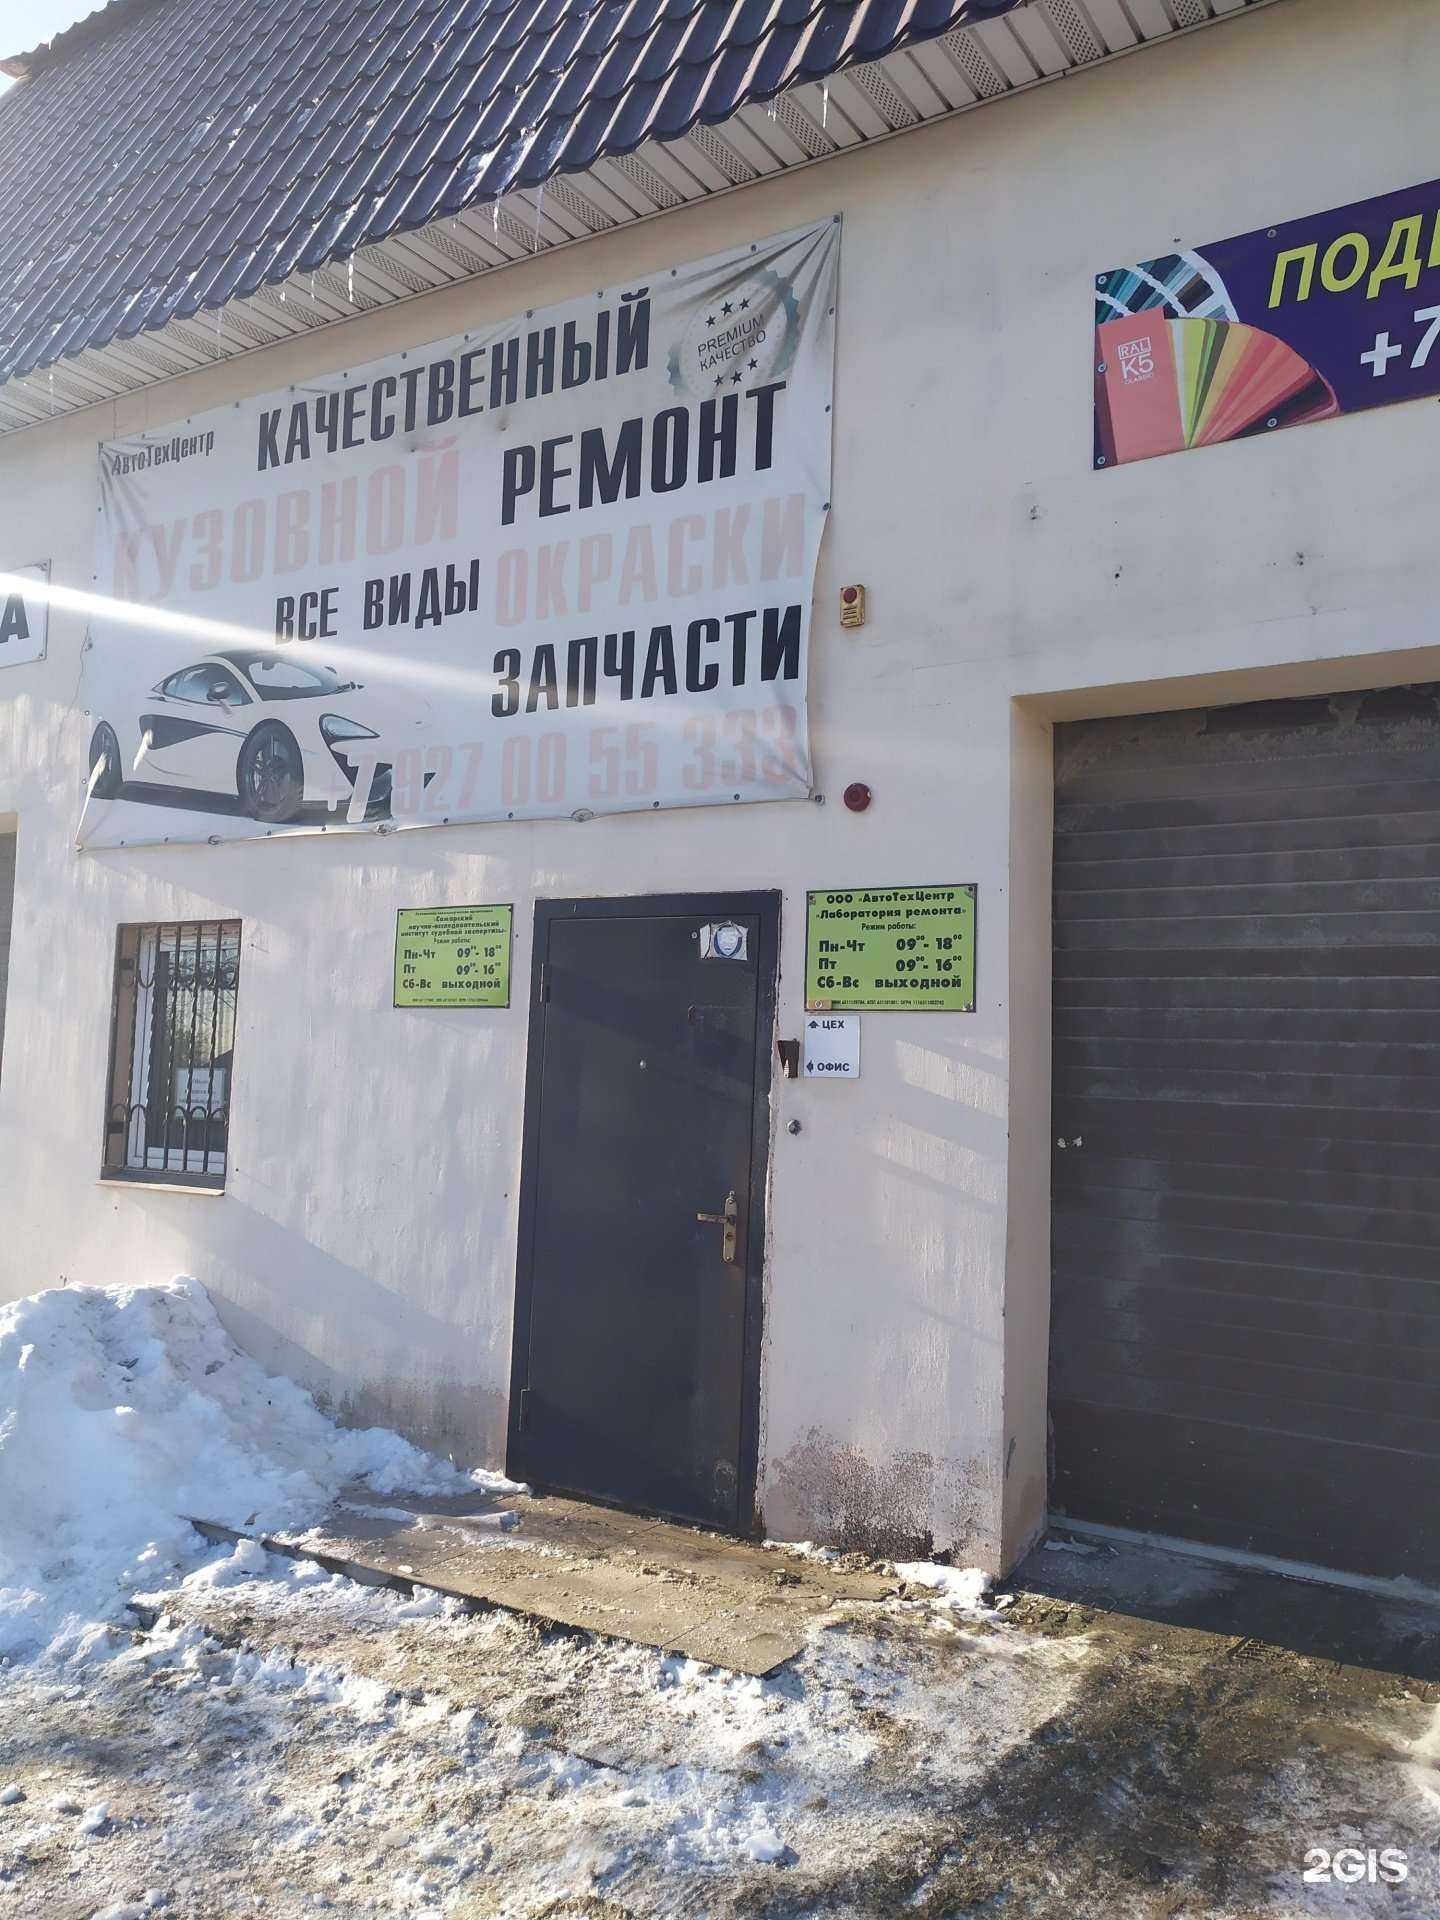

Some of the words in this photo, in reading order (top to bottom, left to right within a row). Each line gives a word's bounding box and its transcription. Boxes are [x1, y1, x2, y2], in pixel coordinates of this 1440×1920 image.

[1268, 209, 1440, 309] ПОД
[697, 314, 765, 357] PREMIUM
[700, 330, 766, 371] КАЧЕСТВО
[1121, 353, 1154, 379] K5
[257, 286, 651, 471] КАЧЕСТВЕННЫЙ
[111, 430, 215, 476] АвтоТехЦентр
[112, 435, 460, 604] КУЗОВНОЙ
[502, 381, 786, 526] РЕМОНТ
[275, 587, 340, 645] ВСЕ
[363, 558, 480, 630] ВИДЫ
[495, 493, 806, 627] ОКРАСКИ
[491, 604, 802, 717] ЗАПЧАСТИ
[393, 742, 485, 815] 927
[503, 732, 568, 808] 00
[589, 721, 659, 799] 55
[826, 895, 853, 904] ООО
[861, 923, 885, 931] Режим
[403, 949, 436, 959] Пн-Чт
[819, 940, 865, 952] Пн-Чт
[403, 964, 416, 974] Пт
[818, 957, 837, 970] Пт
[402, 979, 432, 989] Сб-Вс
[441, 977, 501, 990] выходной
[817, 976, 859, 988] Сб-Вс
[874, 975, 962, 989] выходной
[822, 1020, 845, 1030] ЦЕХ
[817, 1062, 850, 1071] ОФИС
